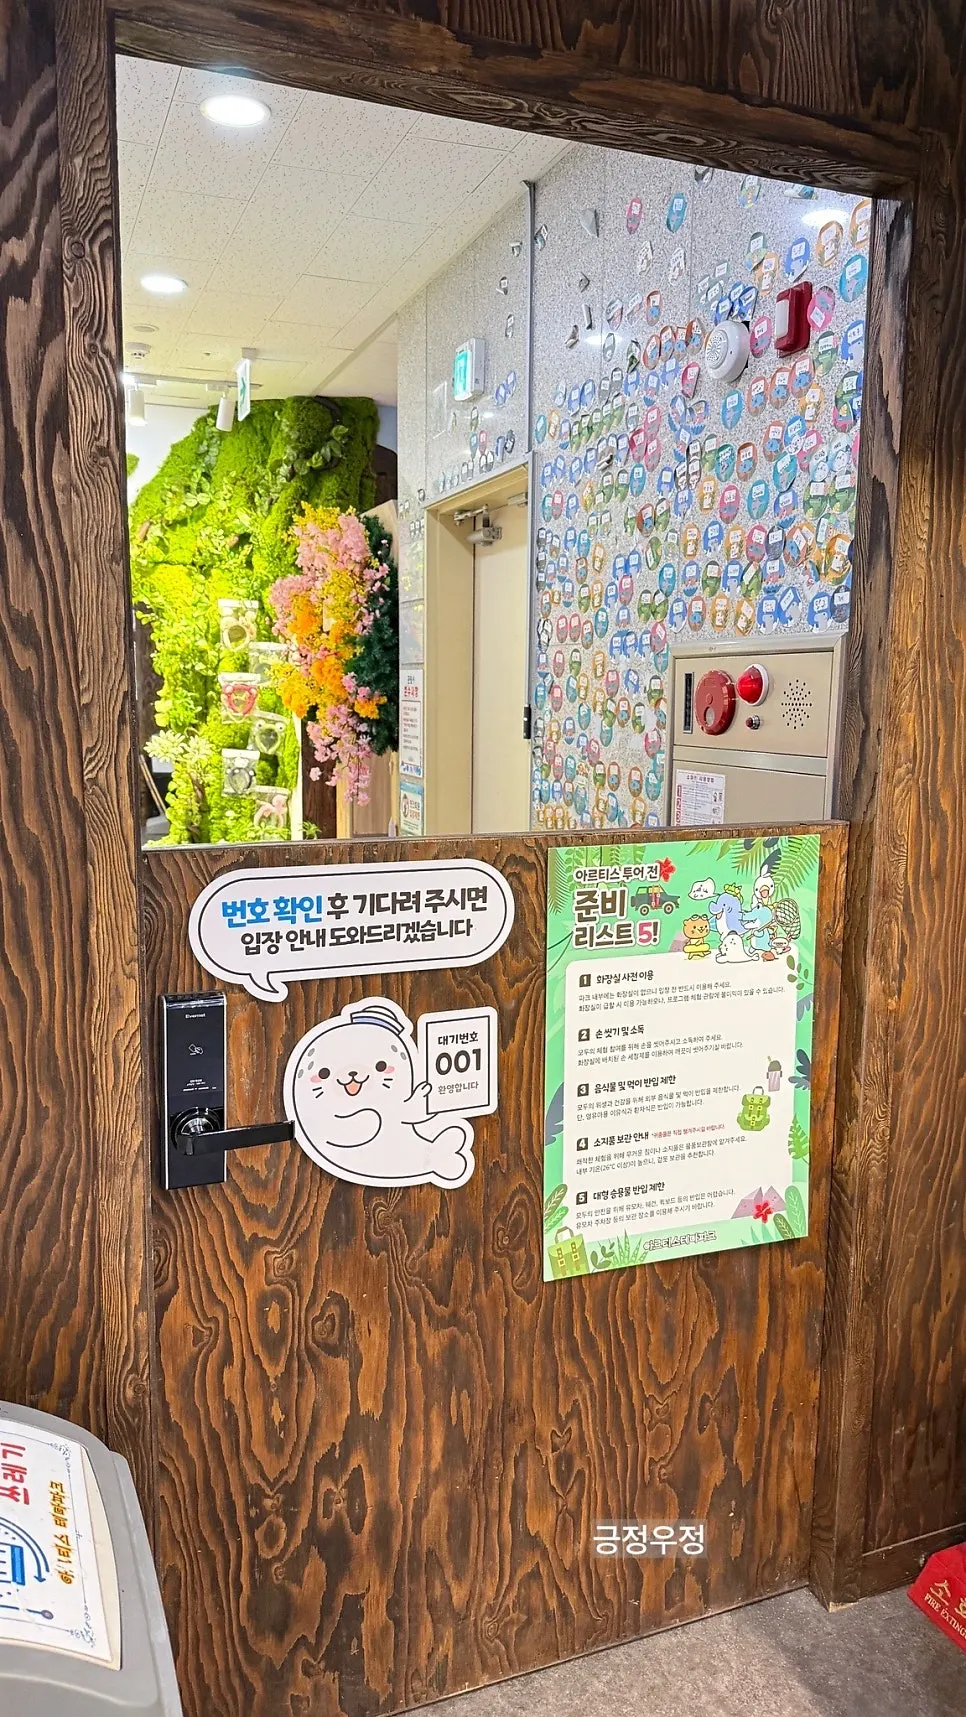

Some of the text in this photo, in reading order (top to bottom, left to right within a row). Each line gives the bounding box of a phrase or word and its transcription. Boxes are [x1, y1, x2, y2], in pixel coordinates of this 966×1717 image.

[575, 865, 657, 882] 아르티스 투어 전
[222, 886, 487, 928] 번호 확인 후 기다려 주시면
[575, 888, 625, 922] 준비
[241, 919, 474, 955] 입장 안내 도와드리겠습니다
[574, 921, 658, 948] 리스트 5!
[596, 972, 620, 984] 화장실
[621, 971, 637, 982] 사전
[639, 969, 653, 981] 이용
[578, 1002, 601, 1011] 화장실이
[603, 1001, 614, 1009] 급할
[616, 1000, 622, 1008] 시
[624, 999, 634, 1007] 이용
[667, 994, 688, 1003] 프로그램
[690, 993, 701, 1001] 체험
[721, 989, 742, 998] 불이익이
[743, 988, 753, 996] 있을
[756, 987, 760, 995] 수
[762, 985, 785, 994] 있습니다.
[579, 993, 590, 1001] 파크
[592, 991, 614, 1000] 내부에는
[616, 989, 638, 998] 화장실이
[640, 987, 657, 996] 없으니
[658, 986, 669, 994] 입장
[678, 984, 694, 992] 반드시
[696, 982, 712, 990] 이용해
[438, 1031, 478, 1045] 대기번호
[595, 1028, 602, 1039] 손
[604, 1026, 619, 1038] 씻기
[621, 1026, 628, 1036] 및
[630, 1024, 644, 1035] 소독
[577, 1056, 600, 1066] 화장실에
[601, 1054, 619, 1063] 배치된
[620, 1053, 626, 1061] 손
[627, 1051, 649, 1060] 세정제를
[651, 1048, 673, 1058] 이용하여
[675, 1047, 691, 1055] 깨끗이
[578, 1047, 594, 1056] 모두의
[596, 1046, 607, 1054] 체험
[609, 1044, 626, 1052] 참여를
[628, 1042, 639, 1050] 위해
[640, 1041, 651, 1049] 손을
[653, 1038, 680, 1048] 씻어주시고
[682, 1035, 704, 1044] 소독하여
[435, 1048, 481, 1075] 001
[438, 1081, 479, 1095] 환영합니다
[581, 1074, 676, 1095] 3 음식물 및 먹이 반입 제한
[577, 1084, 741, 1111] 모두의 위생과 건강을 위해 외부 음식물 및 먹이 반입을 제한합니다.
[586, 1110, 607, 1120] 영유아용
[610, 1107, 632, 1116] 이유식과
[657, 1102, 673, 1110] 반입이
[675, 1098, 704, 1108] 가능합니다.
[579, 1139, 584, 1148] 4
[593, 1135, 615, 1147] 소지품
[617, 1133, 631, 1144] 보관
[633, 1131, 648, 1142] 안내
[576, 1155, 593, 1165] 쾌적한
[595, 1153, 611, 1162] 체험을
[613, 1151, 624, 1159] 위해
[626, 1149, 642, 1158] 무거운
[644, 1146, 660, 1155] 짐이나
[662, 1143, 683, 1153] 소지품은
[576, 1166, 587, 1175] 내부
[657, 1155, 667, 1163] 겉옷
[669, 1153, 685, 1162] 보관을
[579, 1181, 664, 1202] 5 대형 승용물 반입 제한
[576, 1210, 592, 1219] 모두의
[594, 1207, 610, 1216] 안전을
[613, 1205, 624, 1213] 위해
[659, 1197, 675, 1206] 퀵보드
[677, 1195, 688, 1203] 등의
[689, 1193, 705, 1201] 반입은
[707, 1188, 735, 1198] 어렵습니다.
[575, 1219, 592, 1229] 유모차
[594, 1216, 611, 1226] 주차장
[613, 1215, 623, 1223] 등의
[625, 1213, 636, 1221] 보관
[638, 1210, 653, 1219] 장소를
[656, 1207, 672, 1216] 이용해
[674, 1204, 690, 1214] 주시기
[0, 1443, 30, 1506] 쓰레기
[924, 1593, 941, 1612] FIRE
